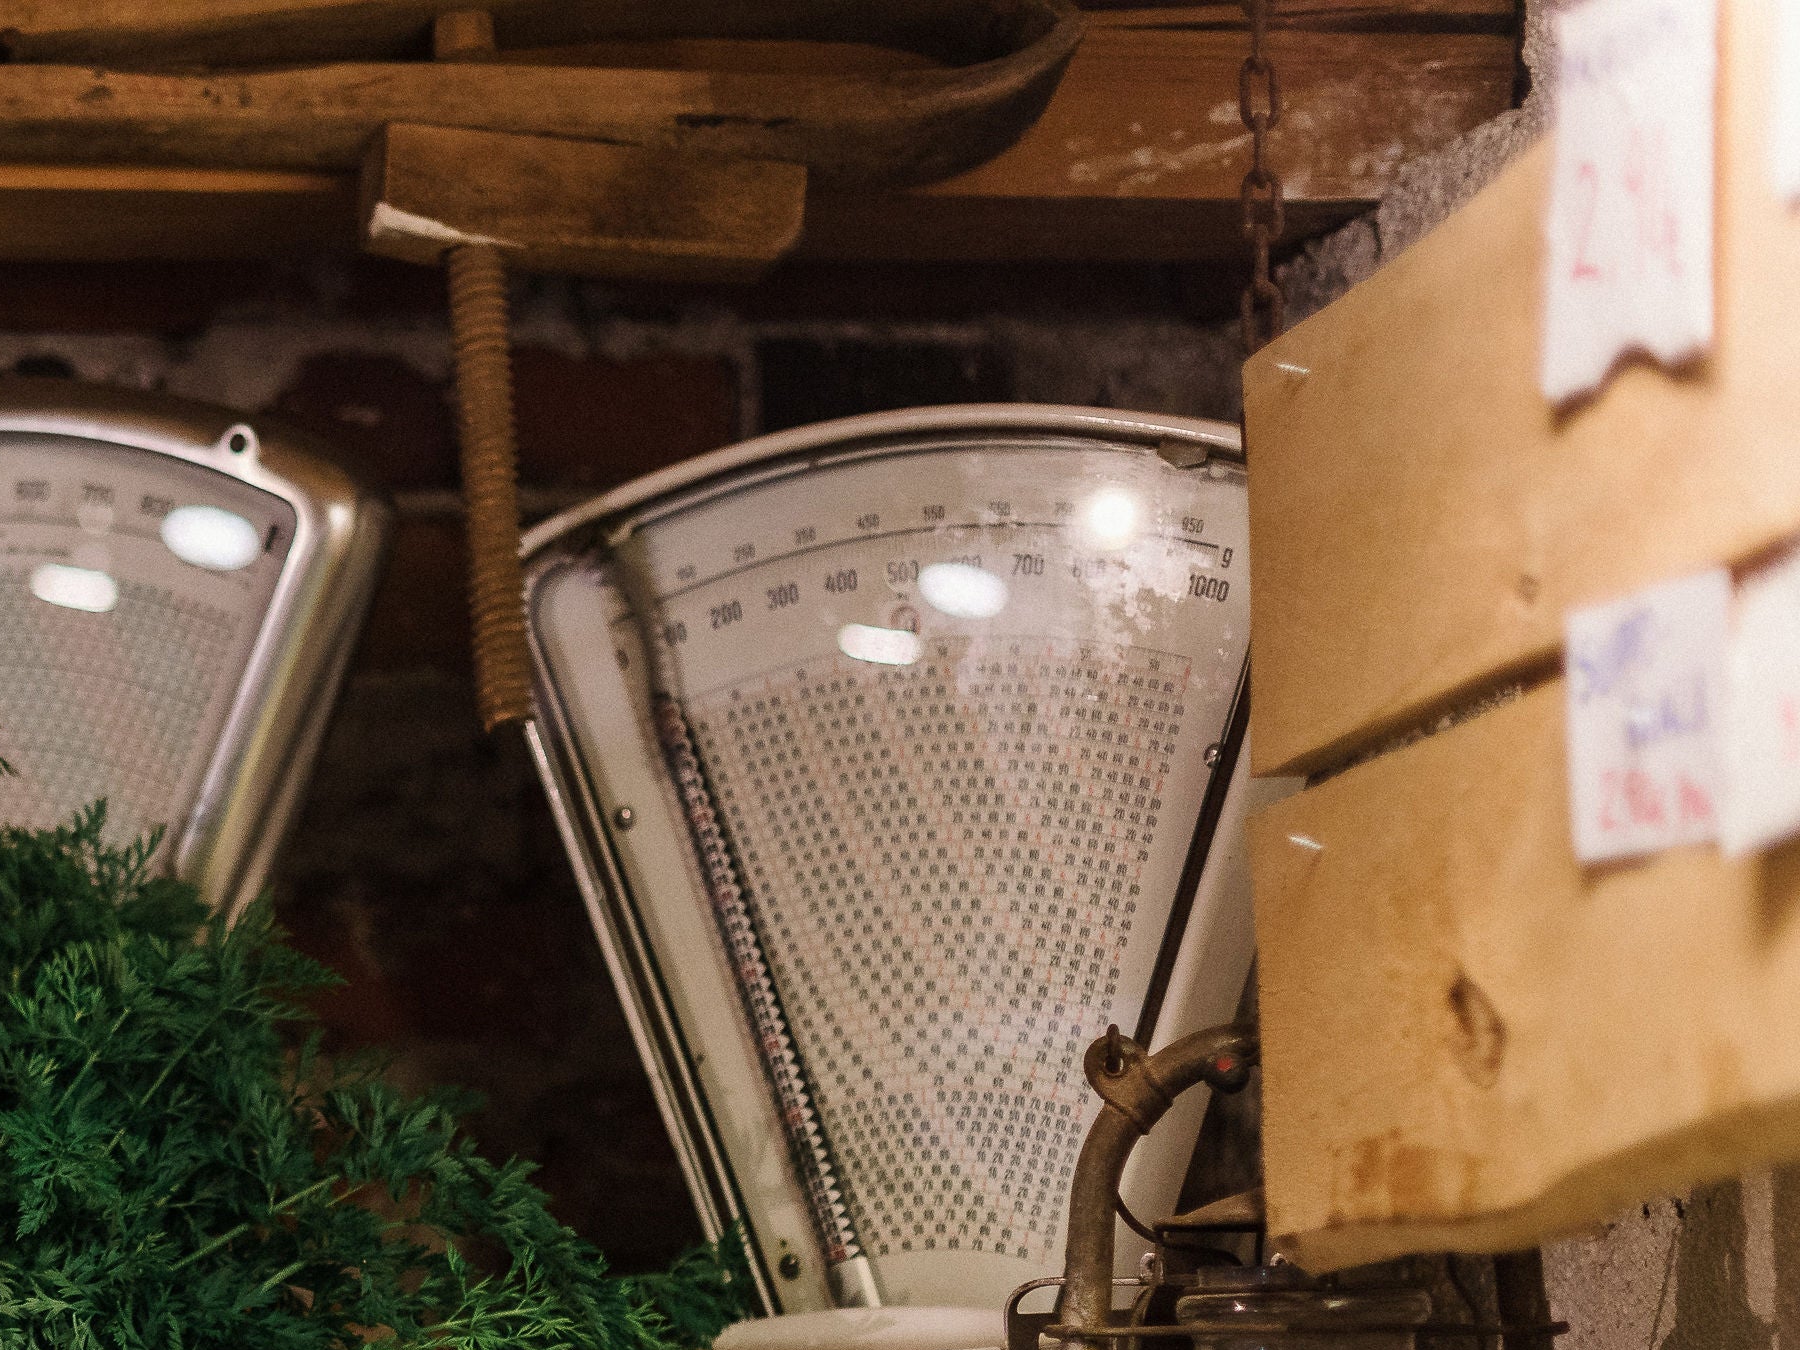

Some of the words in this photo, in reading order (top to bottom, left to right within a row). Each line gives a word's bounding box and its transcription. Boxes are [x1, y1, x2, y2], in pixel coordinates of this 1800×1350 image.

[1220, 547, 1234, 571] g
[710, 600, 743, 630] 200
[766, 582, 800, 611] 300
[824, 568, 856, 594] 400
[1011, 552, 1044, 577] 700
[1187, 573, 1230, 603] 1000
